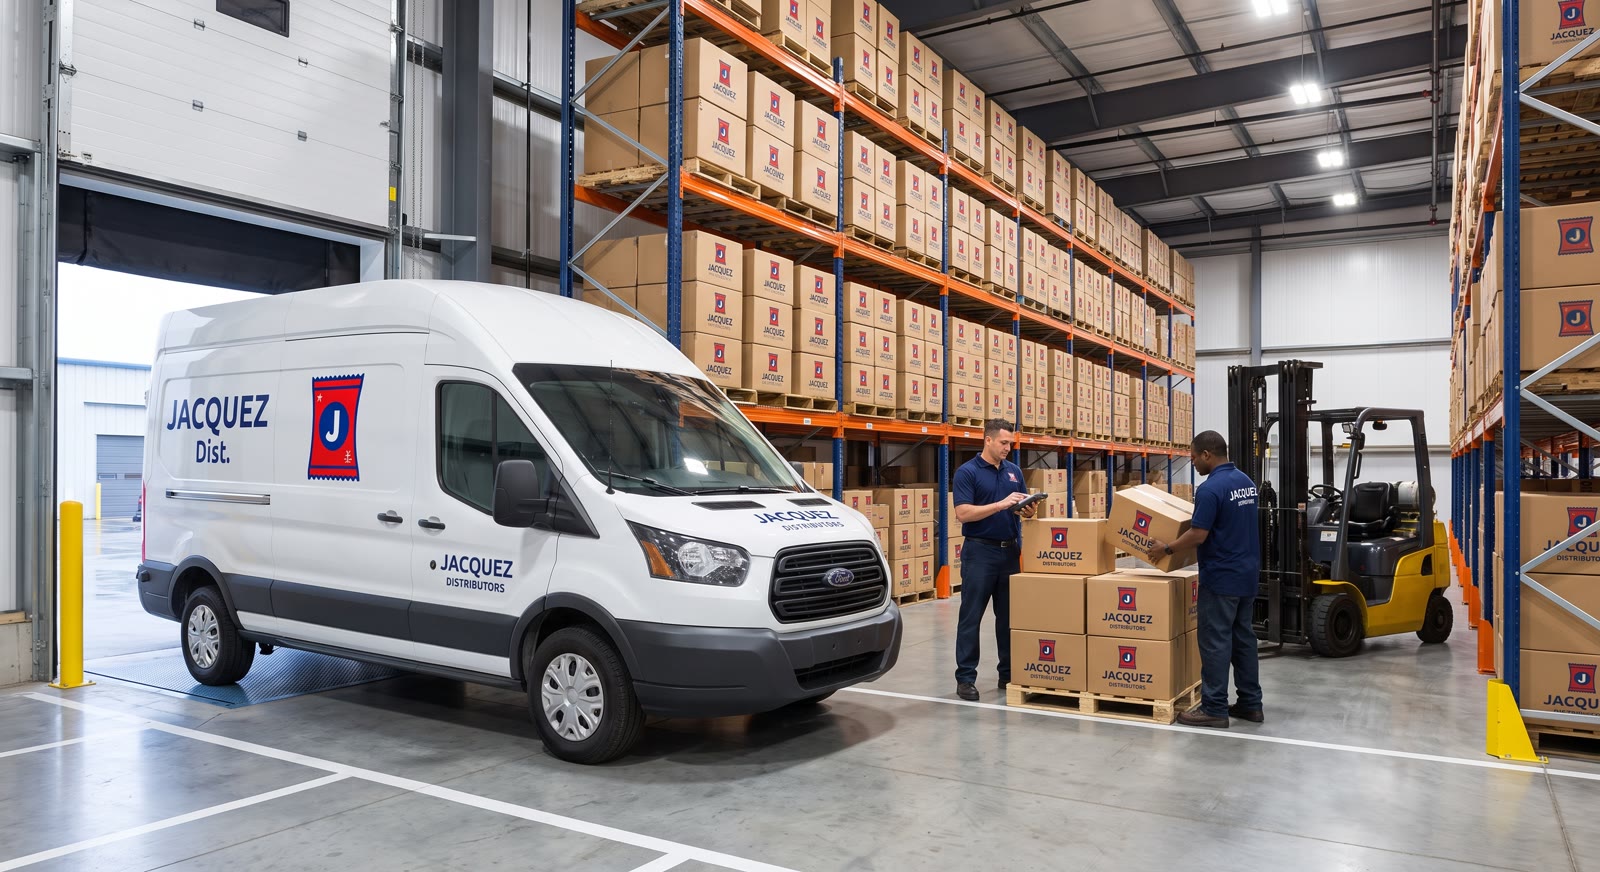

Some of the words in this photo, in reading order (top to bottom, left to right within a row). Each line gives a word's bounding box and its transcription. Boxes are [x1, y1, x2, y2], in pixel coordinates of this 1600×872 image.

[1568, 8, 1575, 19] J
[1550, 28, 1594, 40] JACQUEZ
[1569, 229, 1580, 242] J
[707, 314, 733, 326] JACQUEZ
[1571, 312, 1580, 324] J
[706, 364, 732, 375] JACQUEZ
[167, 394, 269, 436] JACQUEZ
[326, 410, 340, 442] J
[196, 438, 230, 463] Dist.
[754, 510, 840, 523] JACQUEZ
[1578, 516, 1587, 528] J
[782, 521, 845, 531] DISTRIBUTORS
[1118, 528, 1154, 548] JACQUE
[1544, 540, 1599, 554] JQU
[1036, 551, 1082, 561] JACQUEZ
[440, 554, 513, 578] JACQUEZ
[447, 577, 505, 592] DISTRIBUTORS
[1102, 612, 1152, 624] JACQUEZ
[1024, 663, 1070, 675] JACQUEZ
[1102, 670, 1152, 683] JACQUEZ
[1578, 674, 1587, 683] J
